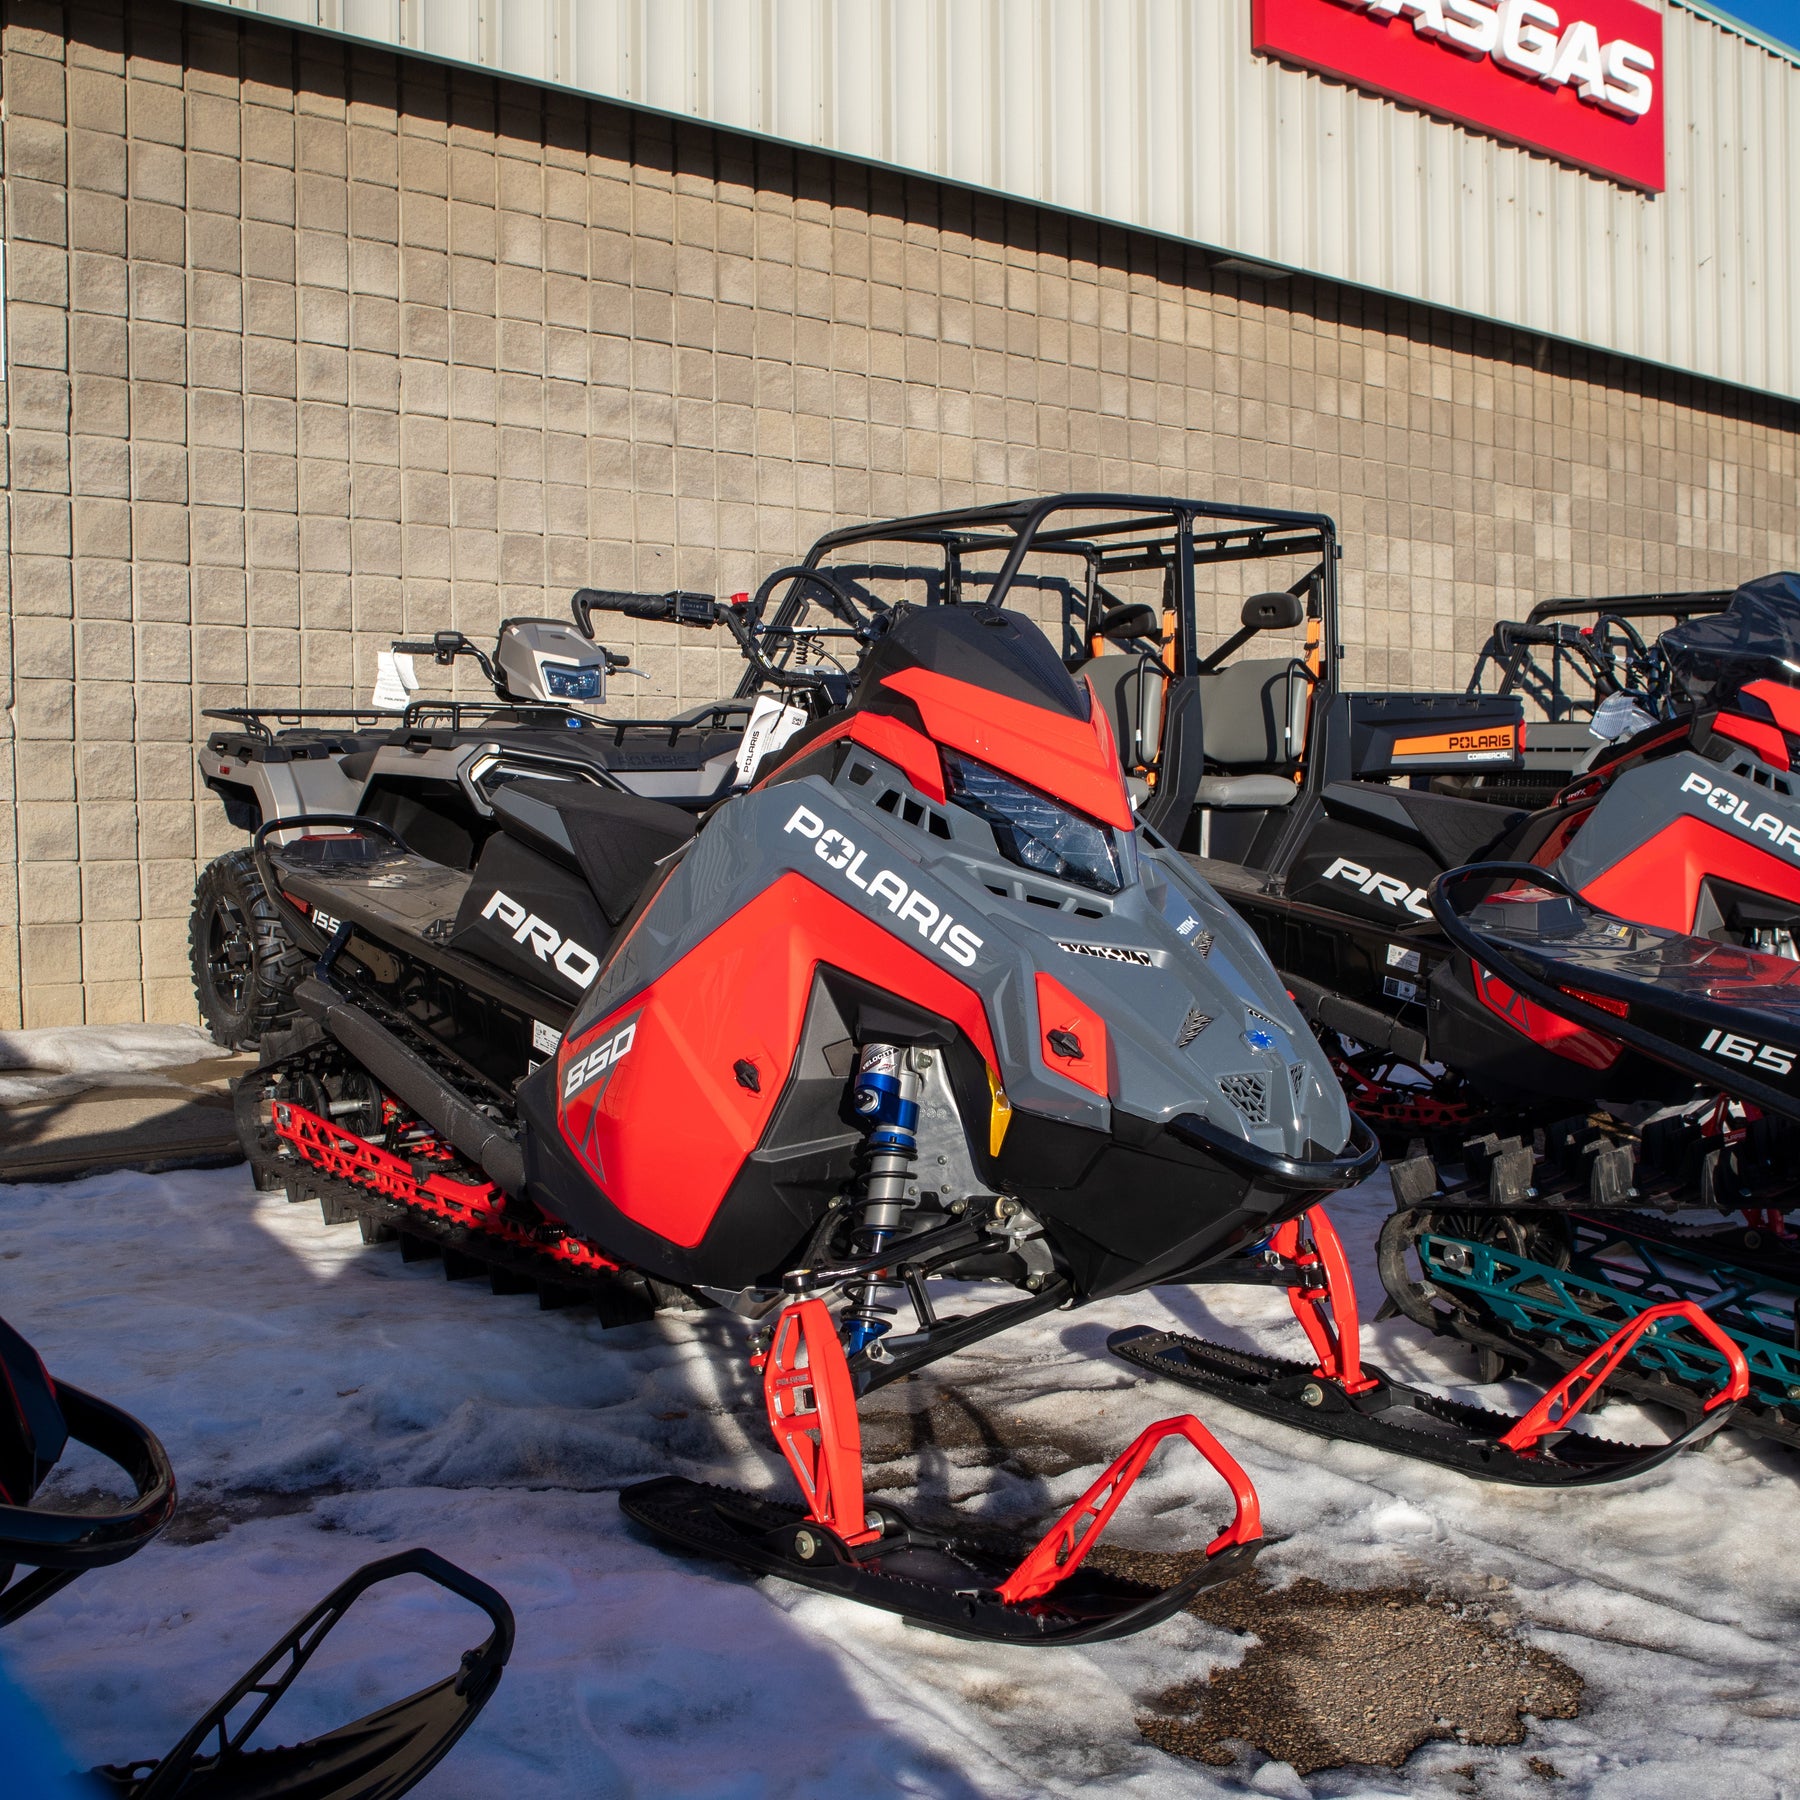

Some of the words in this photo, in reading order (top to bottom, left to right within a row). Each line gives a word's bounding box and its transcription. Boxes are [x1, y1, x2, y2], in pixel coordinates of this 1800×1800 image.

[1366, 0, 1655, 115] SGAS
[743, 730, 760, 773] POLARIS
[1449, 734, 1511, 749] POLARIS
[1467, 752, 1511, 760] COMMERCIAL
[783, 804, 984, 967] POLARIS
[312, 908, 341, 934] 155
[481, 890, 600, 989] PRO
[564, 1022, 637, 1099] 850
[1701, 1028, 1797, 1075] 165
